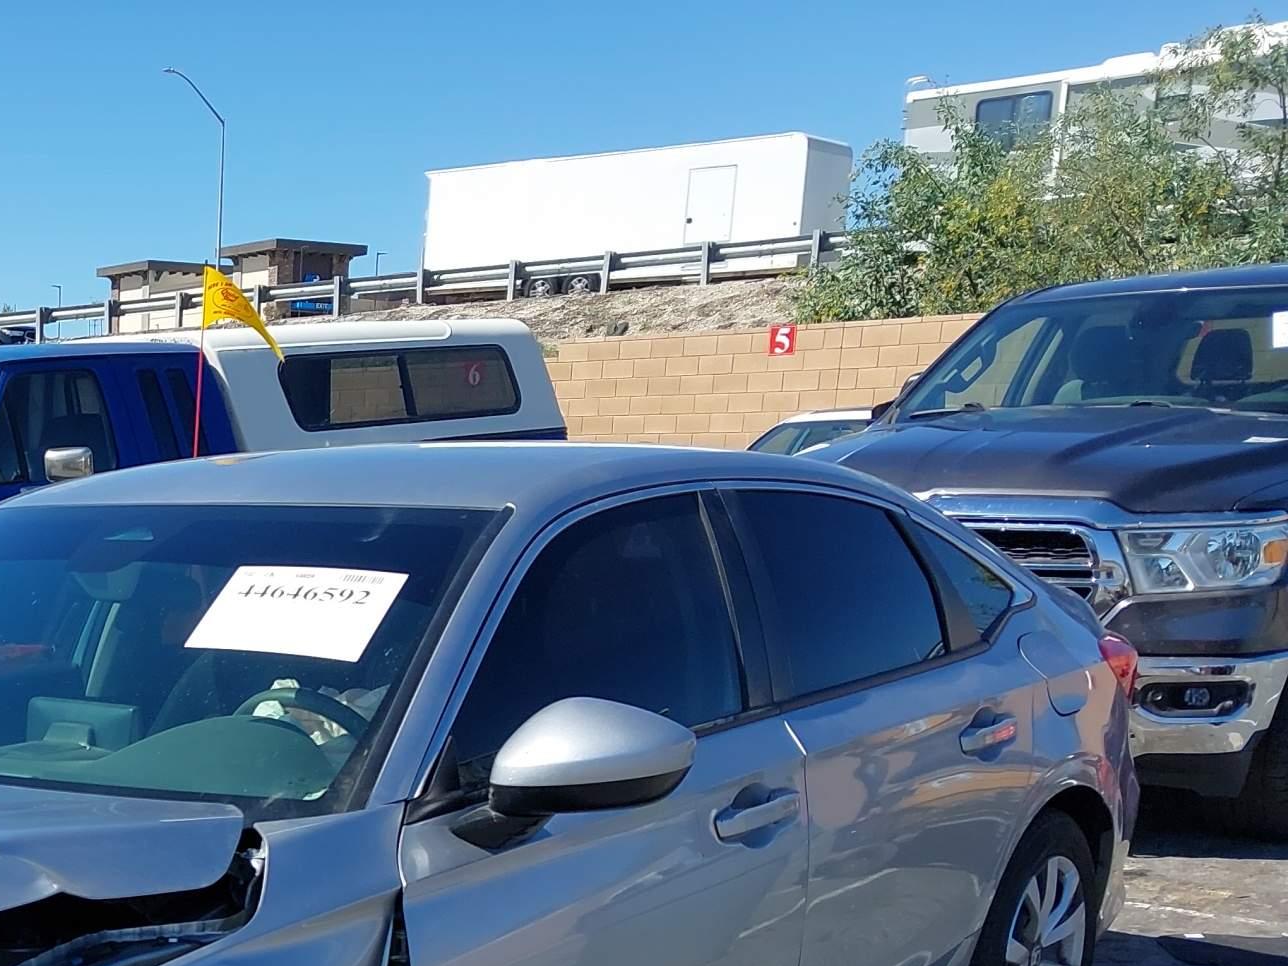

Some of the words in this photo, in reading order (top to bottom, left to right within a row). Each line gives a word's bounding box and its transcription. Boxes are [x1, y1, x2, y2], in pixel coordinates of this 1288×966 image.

[774, 327, 791, 354] 5
[468, 362, 481, 385] 6
[238, 584, 370, 605] 44646592
